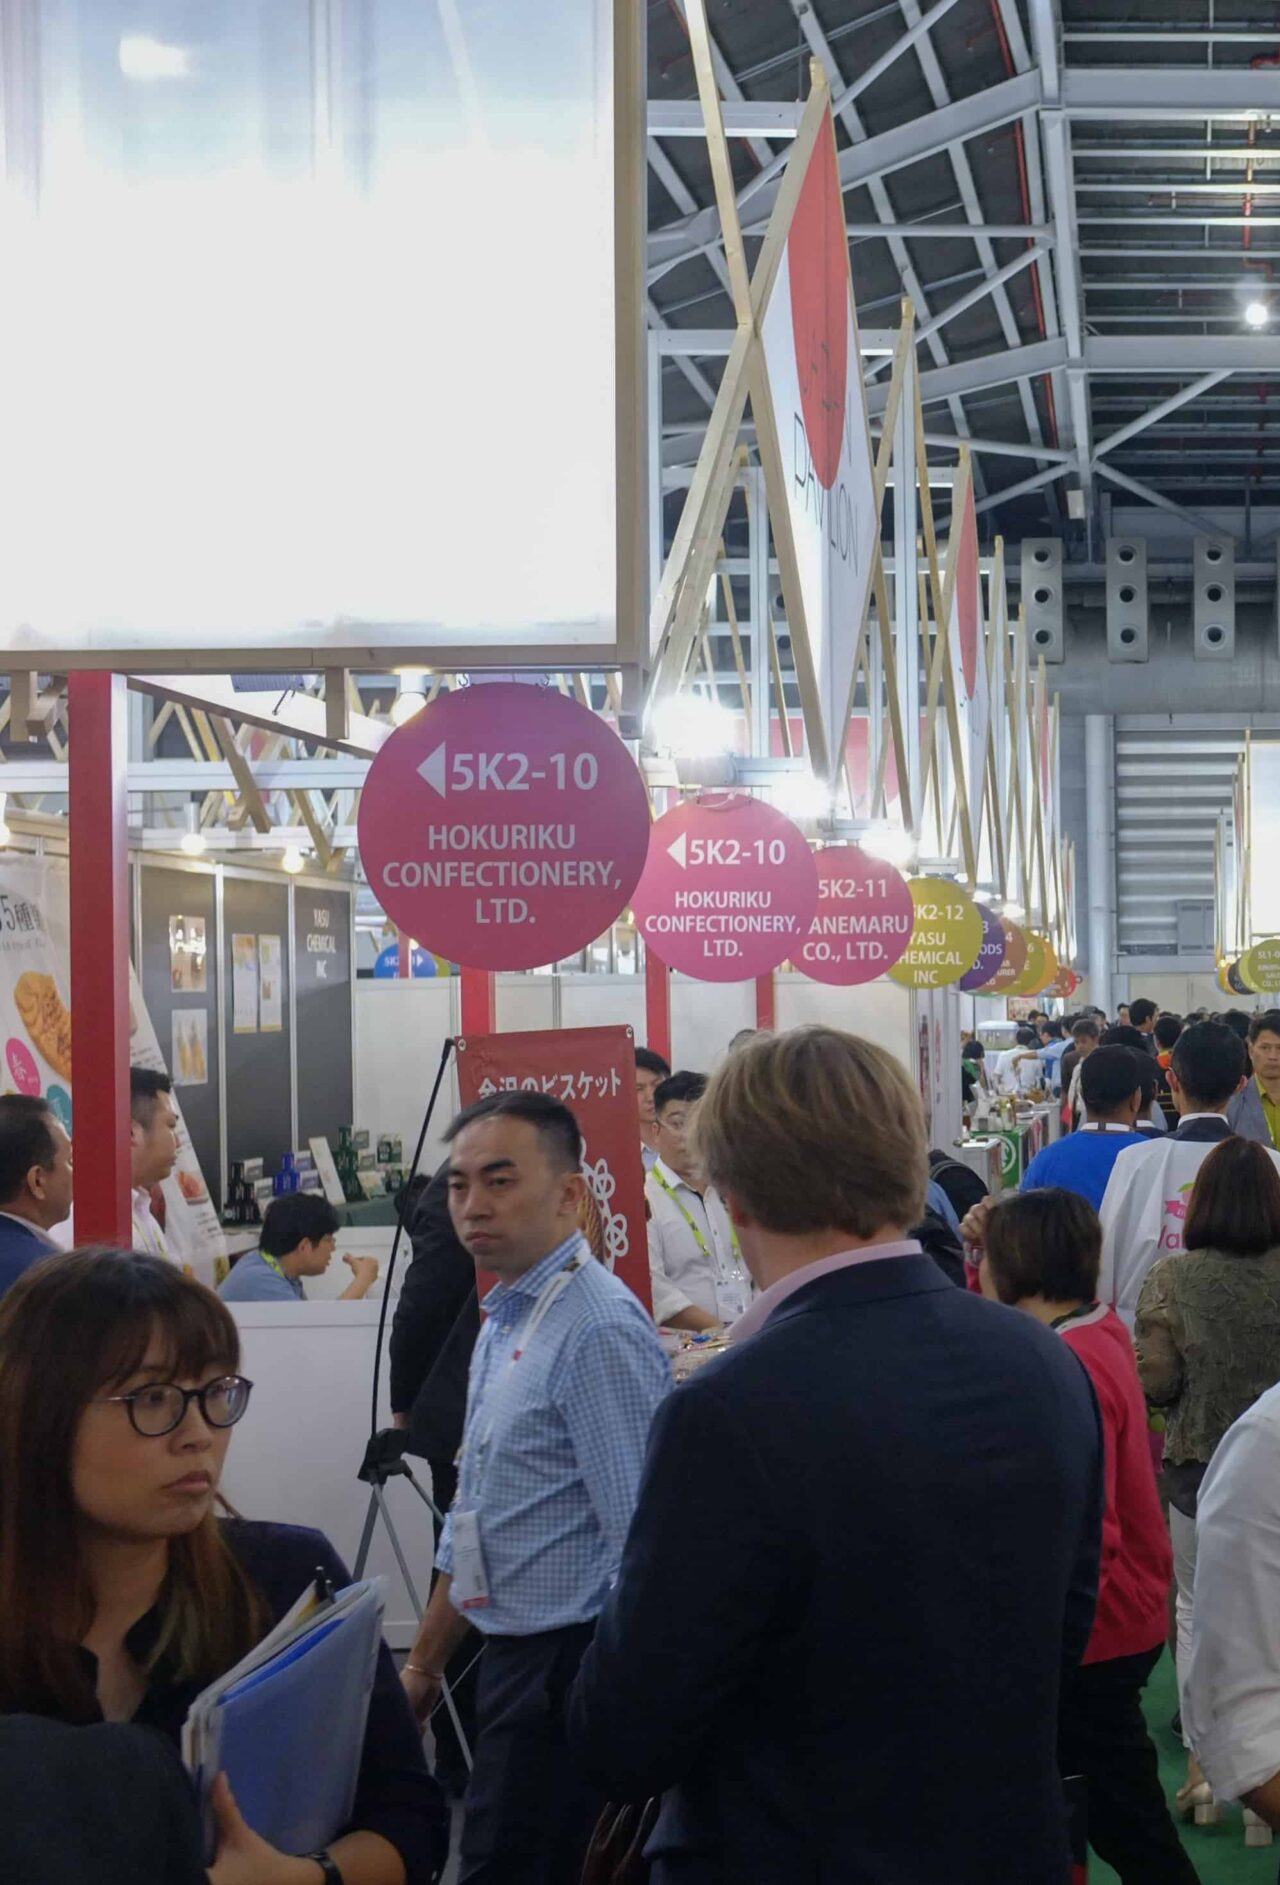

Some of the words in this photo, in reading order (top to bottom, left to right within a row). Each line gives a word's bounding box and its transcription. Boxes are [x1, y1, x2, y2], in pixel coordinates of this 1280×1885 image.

[451, 751, 599, 792] 5K2-10
[428, 823, 577, 851] HOKURIKU
[689, 838, 786, 867] 5K2-10
[382, 861, 622, 894] CONFECTIONERY,
[818, 878, 888, 899] 5K2-11
[474, 897, 536, 924] LTD.
[674, 891, 772, 909] HOKURIKU
[645, 915, 801, 936] CONFECTIONERY,
[808, 915, 909, 935] ANEMARU
[703, 939, 744, 958] LTD.
[909, 932, 946, 946] YASU
[802, 941, 841, 963] CO.,
[846, 941, 889, 960] LTD.
[899, 951, 964, 966] HEMICAL
[913, 970, 939, 984] INC
